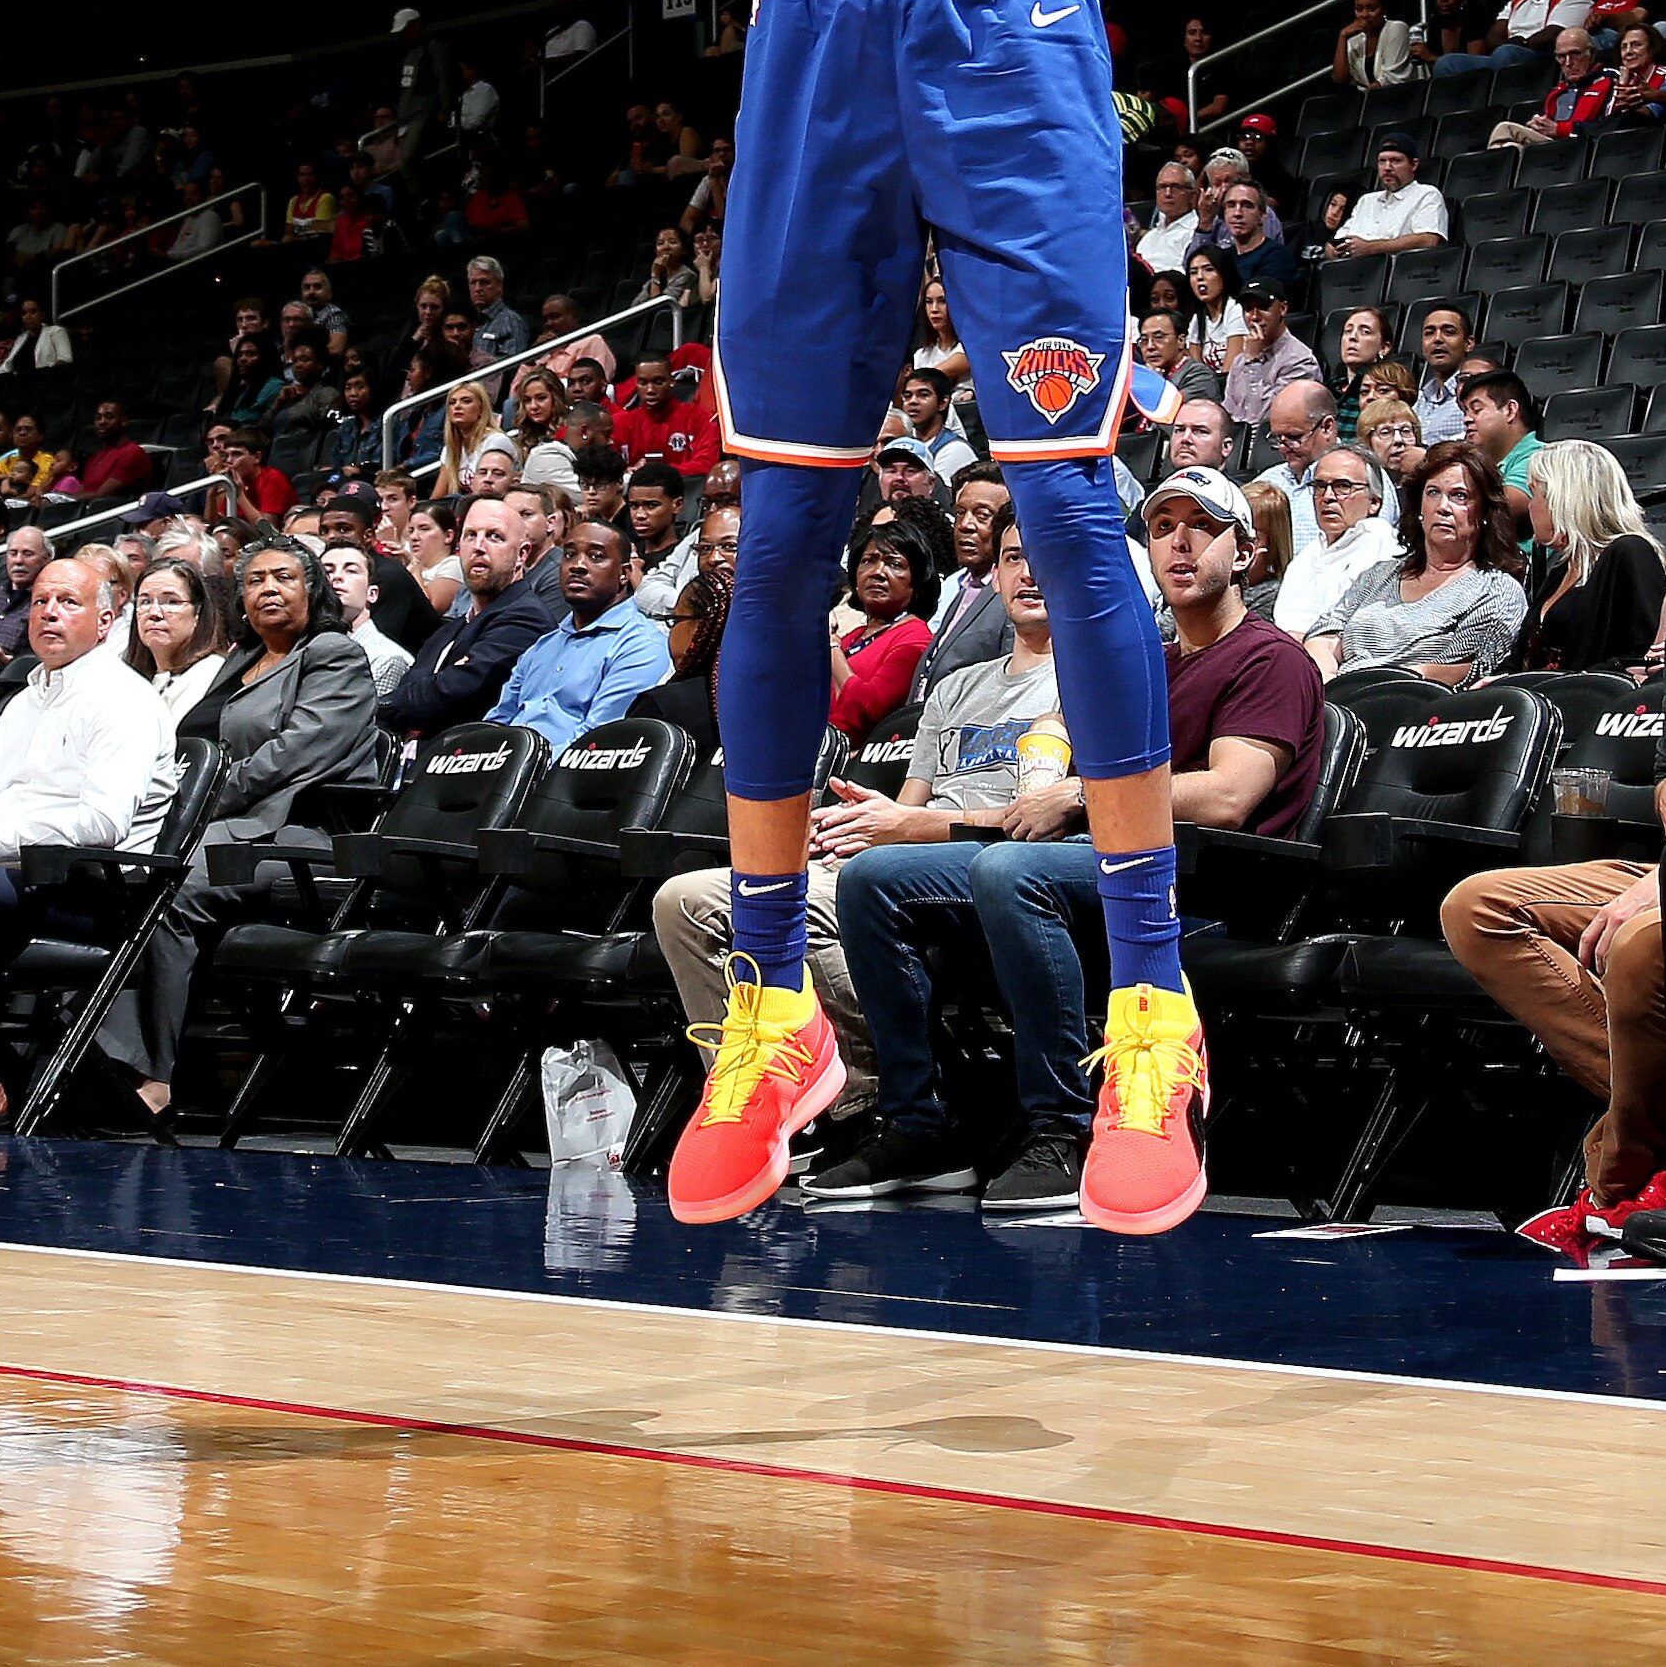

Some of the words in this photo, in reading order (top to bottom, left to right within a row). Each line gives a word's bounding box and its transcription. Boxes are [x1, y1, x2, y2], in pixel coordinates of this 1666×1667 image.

[1012, 348, 1095, 381] KNICKS
[1389, 704, 1515, 749] wizards
[1595, 705, 1665, 740] wiza
[426, 740, 515, 775] wizards
[559, 737, 651, 771] wizards
